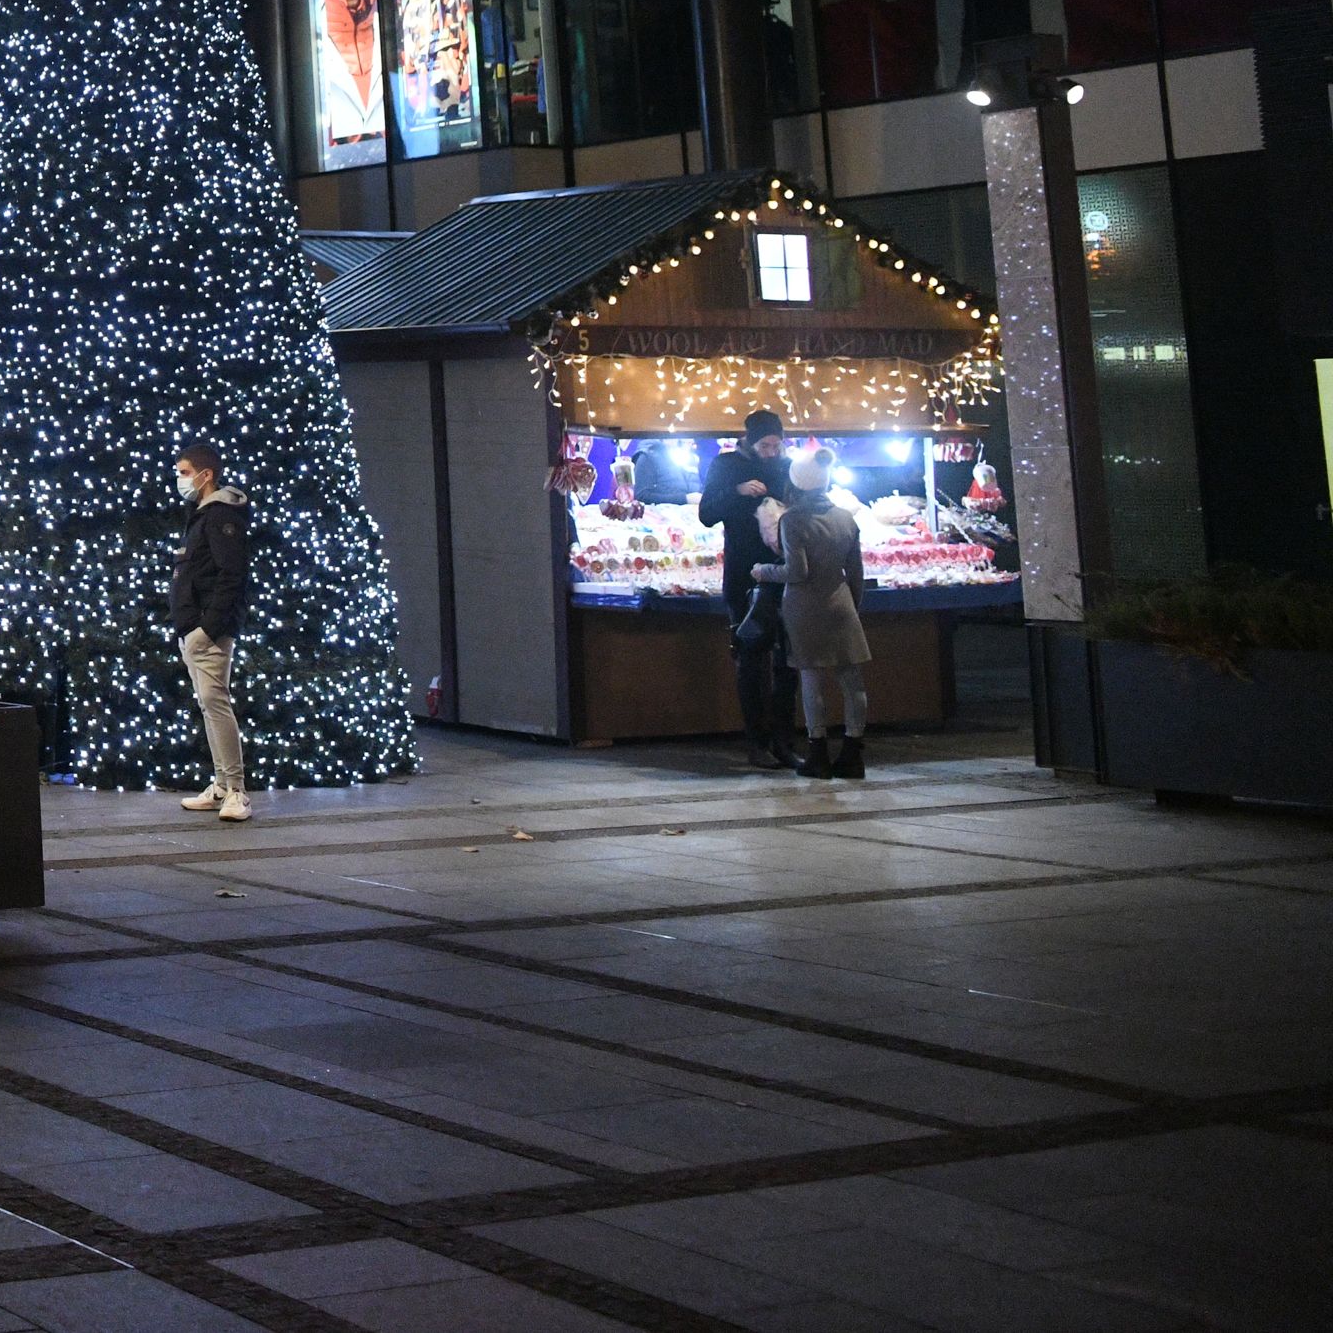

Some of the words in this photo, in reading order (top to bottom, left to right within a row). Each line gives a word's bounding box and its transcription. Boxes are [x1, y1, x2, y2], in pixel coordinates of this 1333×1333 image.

[579, 328, 589, 352] 5
[628, 331, 708, 355] WOOL
[720, 331, 774, 355] ART
[794, 330, 867, 356] HAND
